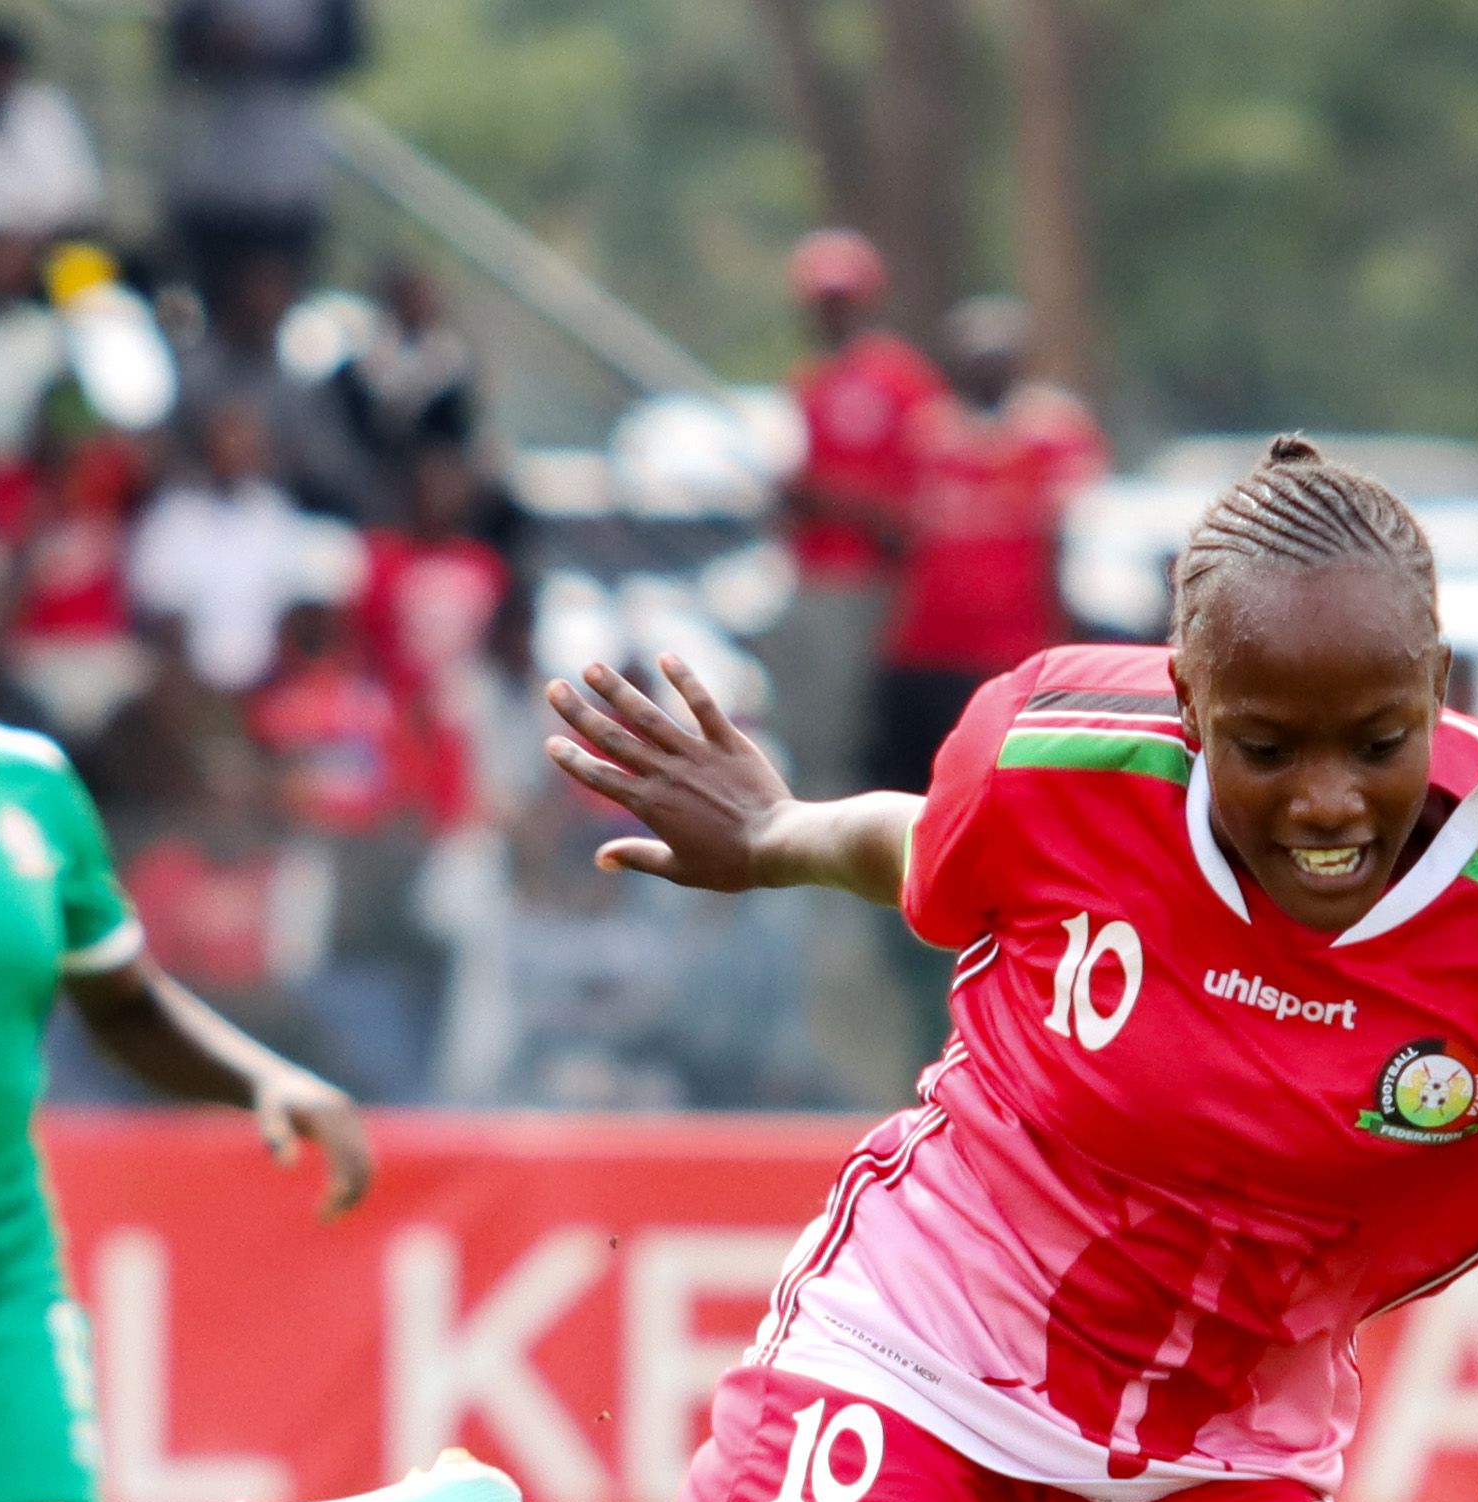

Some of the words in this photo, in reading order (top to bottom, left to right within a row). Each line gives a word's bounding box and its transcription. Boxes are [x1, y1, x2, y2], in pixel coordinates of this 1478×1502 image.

[1044, 911, 1143, 1051] 10
[1203, 968, 1357, 1030] uhlsport
[1381, 1046, 1420, 1115] FOOTBALL
[1379, 1124, 1463, 1143] FEDERATION
